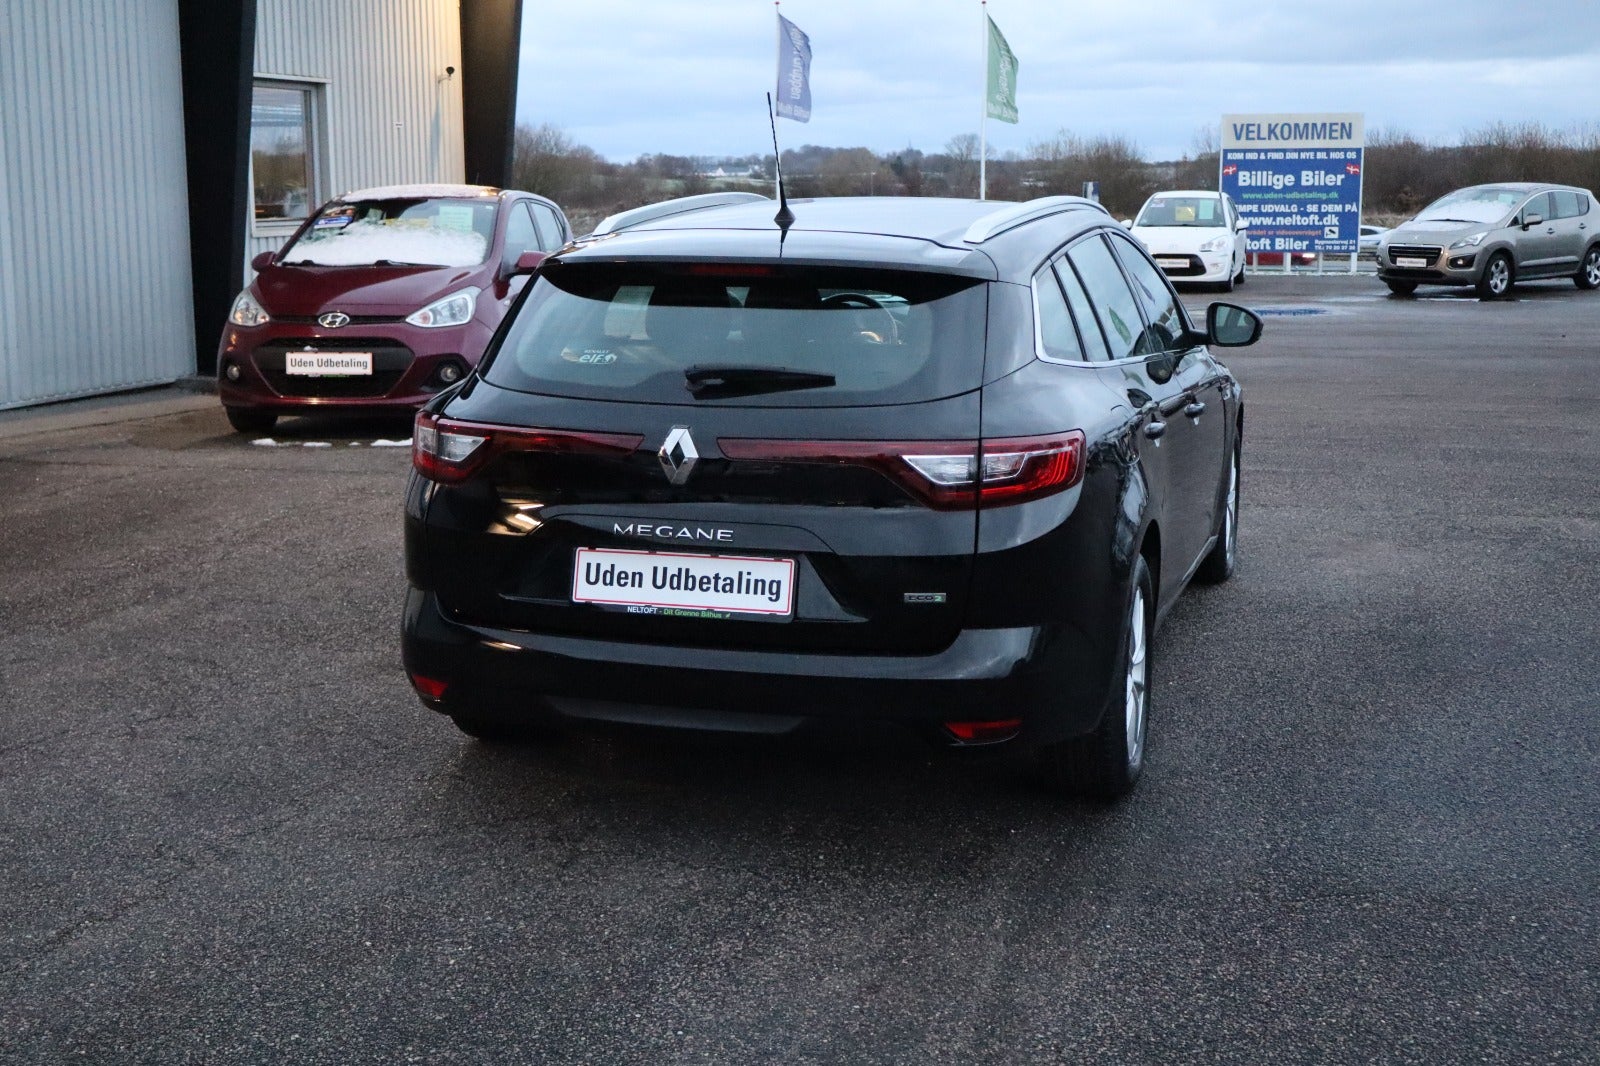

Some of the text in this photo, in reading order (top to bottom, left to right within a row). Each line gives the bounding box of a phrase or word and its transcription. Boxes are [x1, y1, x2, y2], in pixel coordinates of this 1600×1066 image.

[1233, 122, 1353, 141] VELKOMMEN
[1227, 151, 1357, 160] KOM IND & FIND DIN NYE BIL HOS OS
[1238, 170, 1345, 190] Billige Biler
[1242, 191, 1339, 200] www.uden-udbetaling.dk
[1261, 204, 1298, 213] UDVALG
[1306, 204, 1319, 213] SE
[1321, 204, 1343, 213] DEM
[1345, 202, 1358, 213] PÅ
[1246, 238, 1309, 250] toft Biler
[290, 358, 368, 370] Uden Udbetaling
[579, 353, 604, 363] elf
[613, 523, 734, 542] MEGANE
[585, 562, 782, 602] Uden Udbetaling
[627, 606, 658, 615] NELTOFT
[663, 608, 674, 616] Dit
[701, 610, 722, 619] Bilhus
